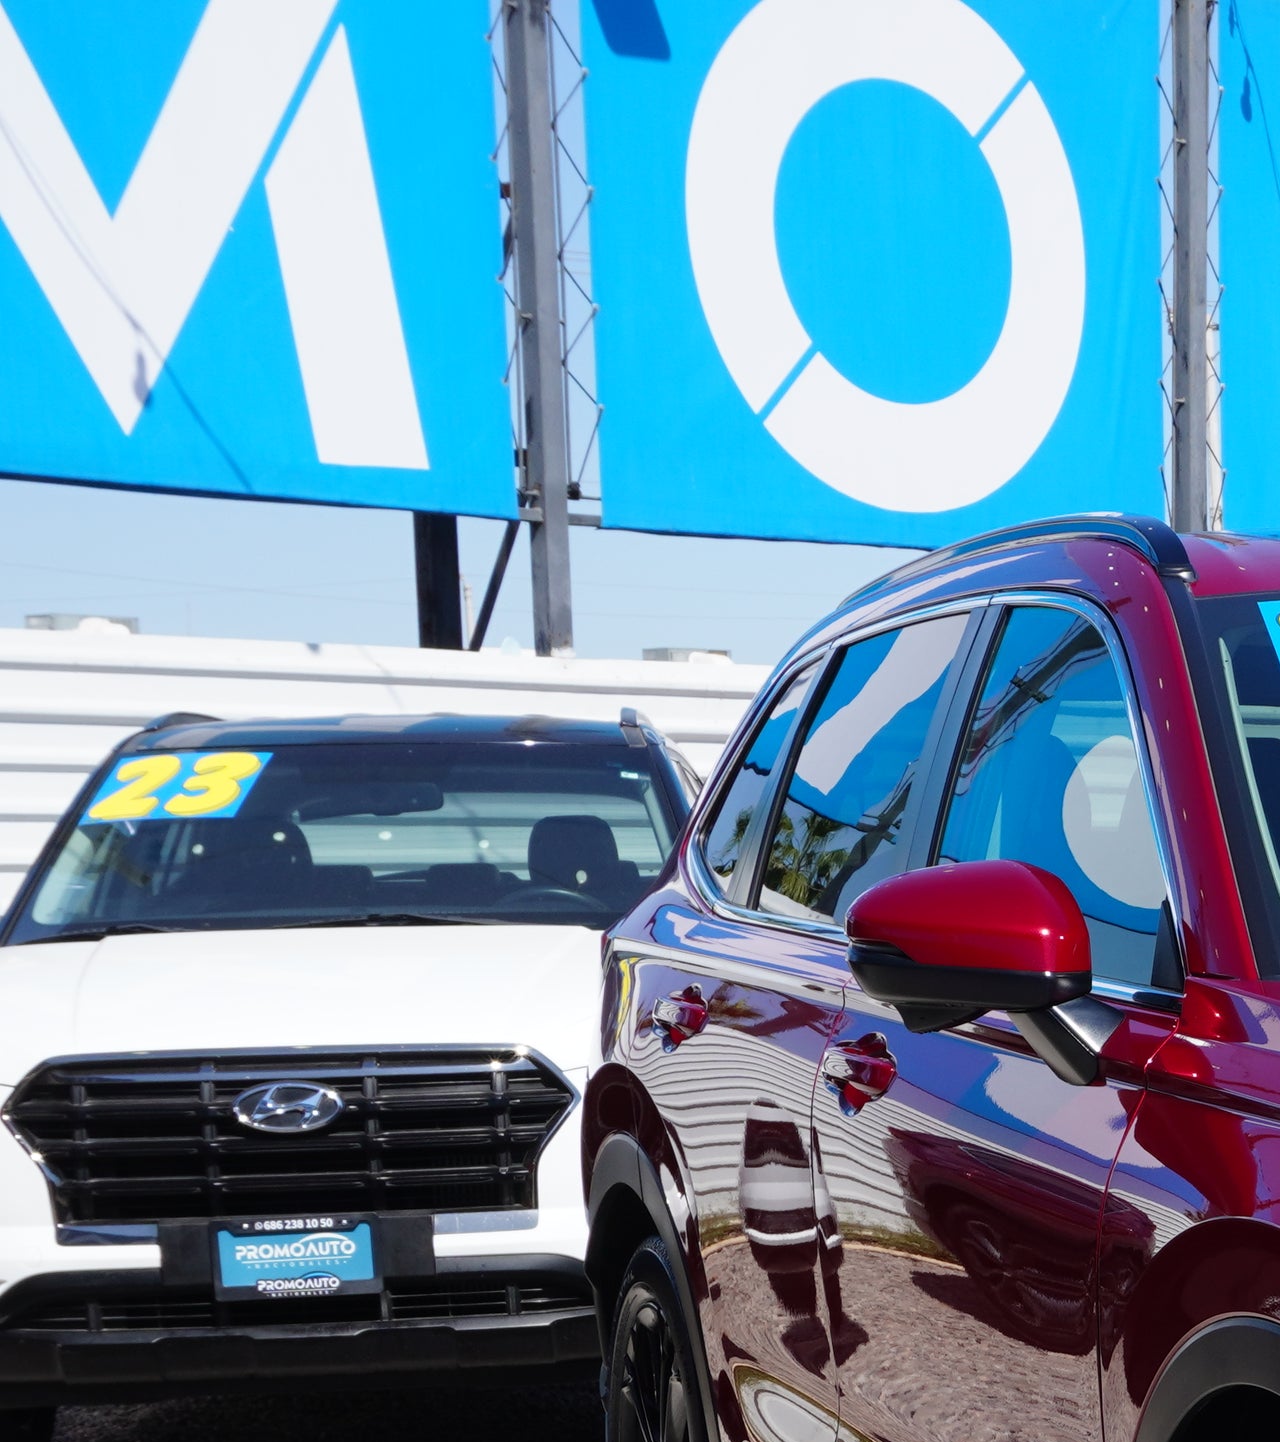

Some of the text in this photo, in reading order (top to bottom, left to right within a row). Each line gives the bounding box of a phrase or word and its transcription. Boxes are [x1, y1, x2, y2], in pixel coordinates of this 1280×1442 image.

[87, 751, 262, 820] 23
[263, 1218, 333, 1230] 686 238 10 50
[235, 1240, 356, 1261] PROMOAUTO
[257, 1277, 340, 1291] PROMOAUTO
